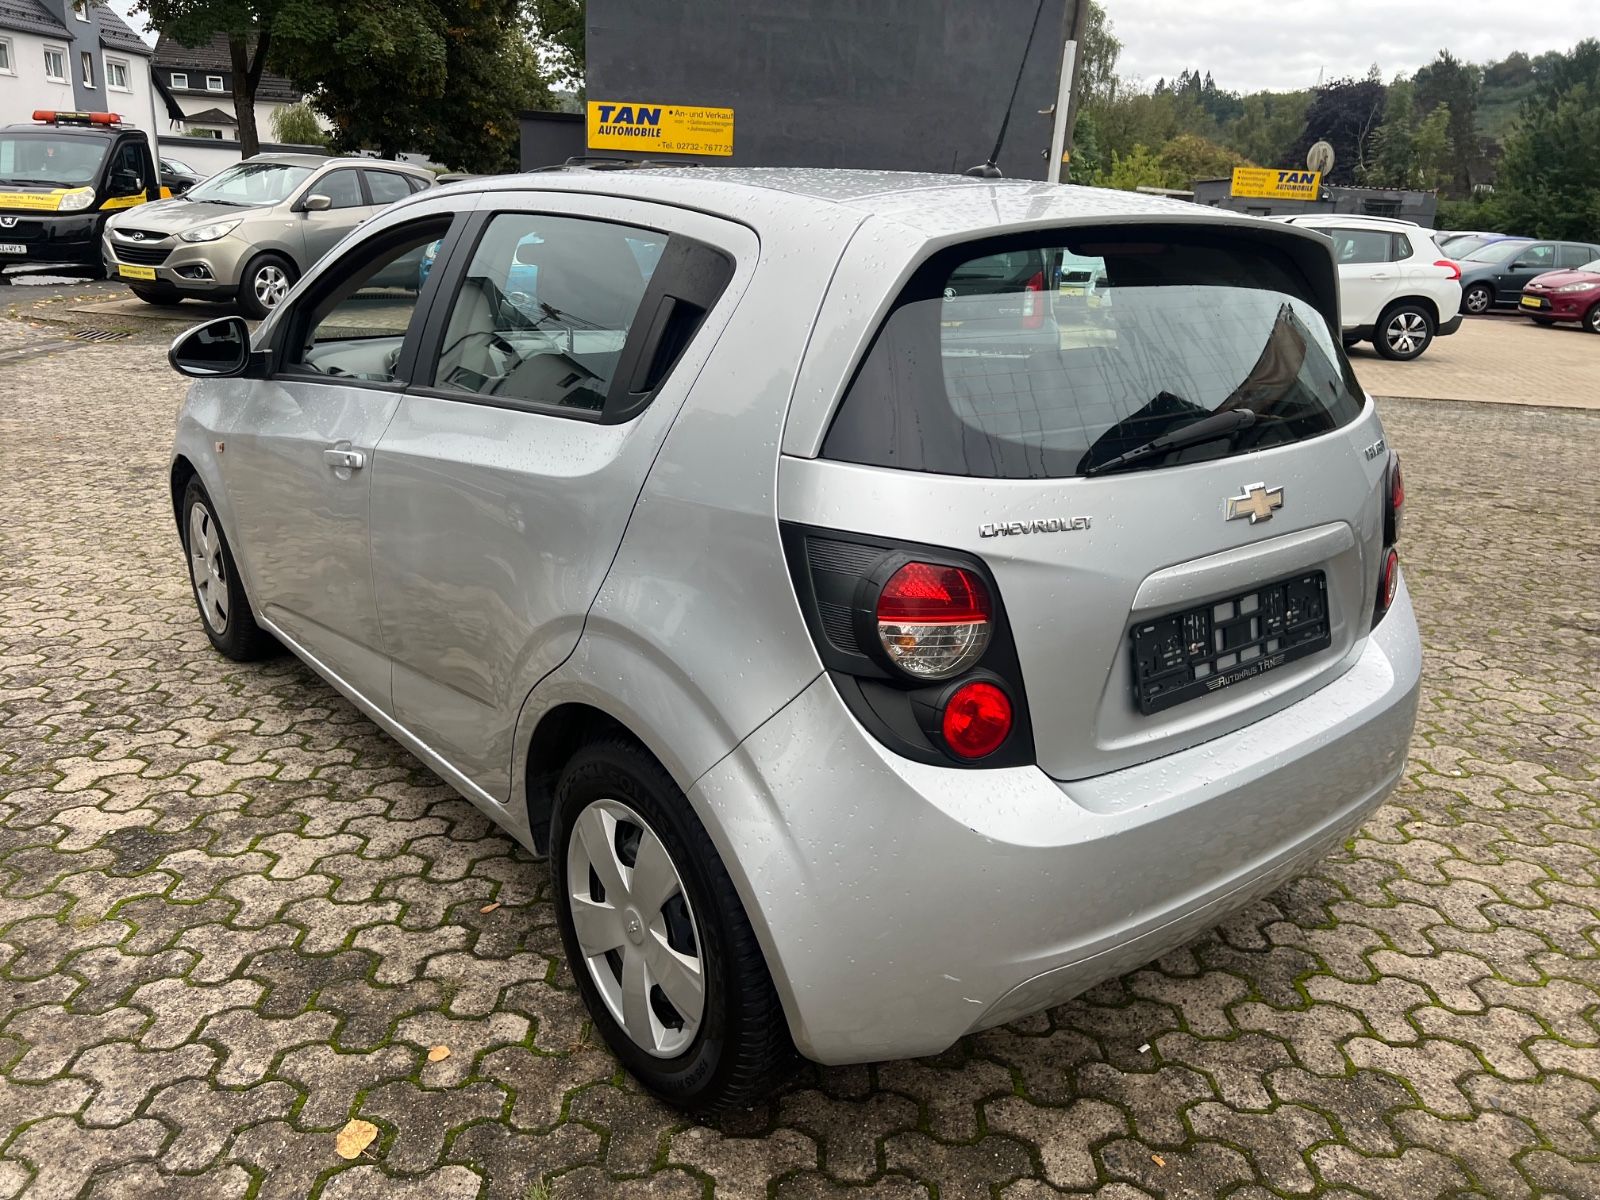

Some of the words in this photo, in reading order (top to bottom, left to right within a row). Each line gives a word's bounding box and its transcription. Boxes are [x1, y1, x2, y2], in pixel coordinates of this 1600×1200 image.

[598, 105, 661, 125] TAN
[598, 125, 661, 138] AUTOMOBILE
[1278, 172, 1315, 184] TAN
[1276, 184, 1313, 192] AUTOMOBILE
[979, 516, 1092, 538] CHEVROLET
[1218, 666, 1257, 686] AUTOHAUS
[1258, 657, 1275, 671] TAN
